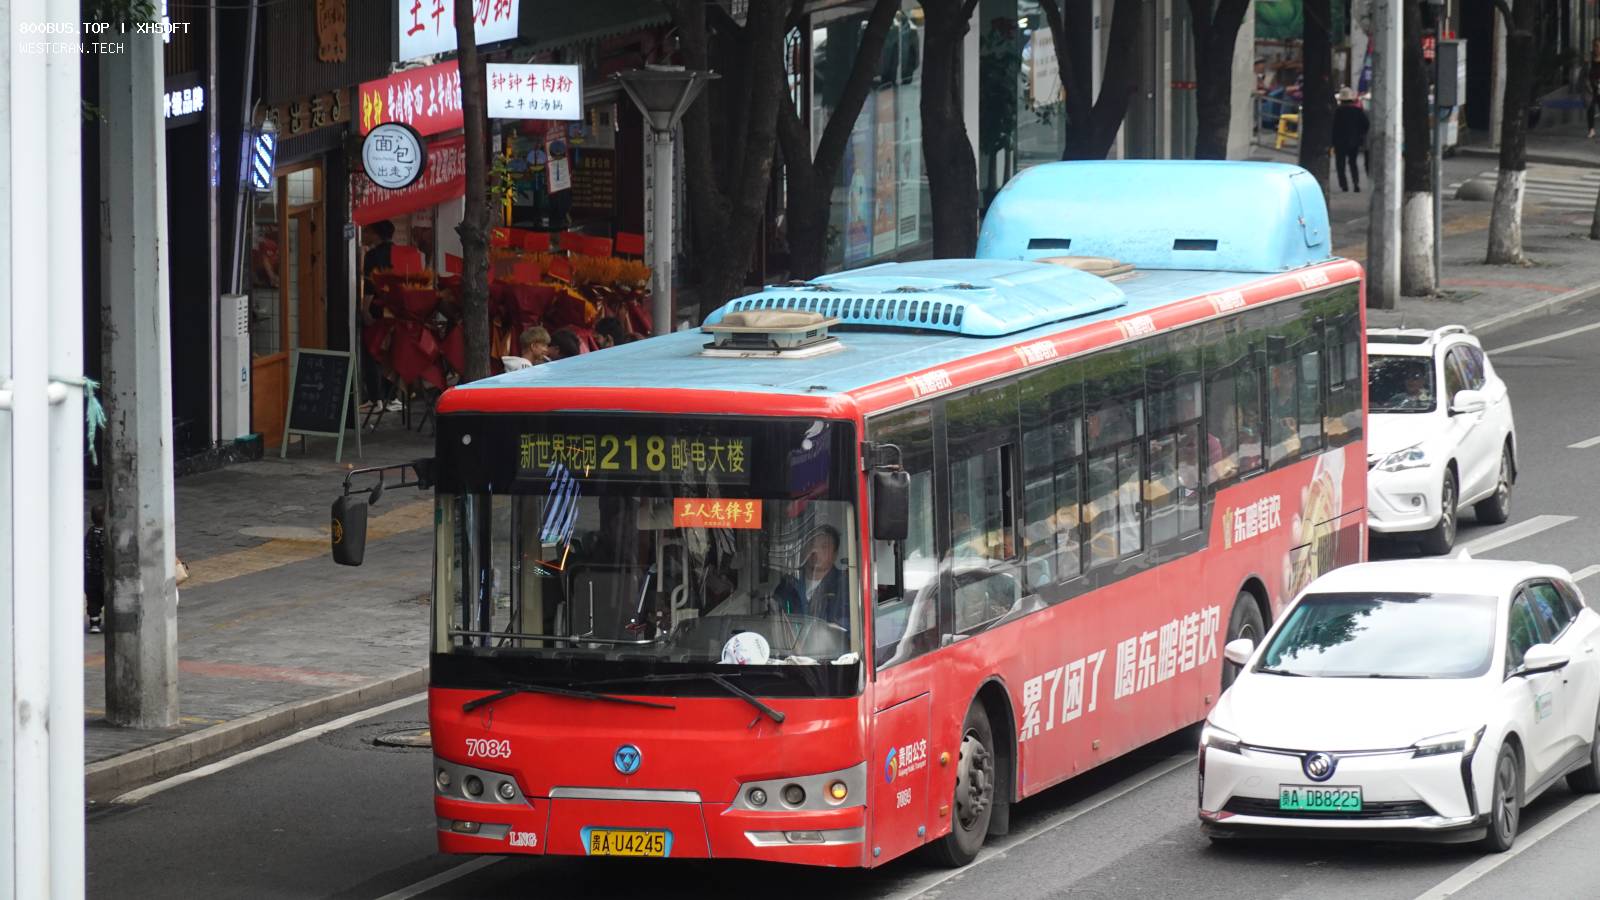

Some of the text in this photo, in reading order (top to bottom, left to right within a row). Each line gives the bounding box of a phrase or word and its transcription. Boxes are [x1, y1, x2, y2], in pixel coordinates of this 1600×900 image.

[492, 72, 573, 93] 钟钟牛肉粉
[373, 135, 413, 164] 面包
[377, 165, 413, 179] 出走了
[520, 433, 745, 473] 新世界花园 218 邮电大楼
[680, 501, 755, 523] 工人先锋号
[1019, 605, 1221, 742] 累了困了 喝东鹏特饮
[466, 738, 511, 758] 7084
[899, 738, 927, 768] 贵阳公交
[509, 832, 537, 846] LNG
